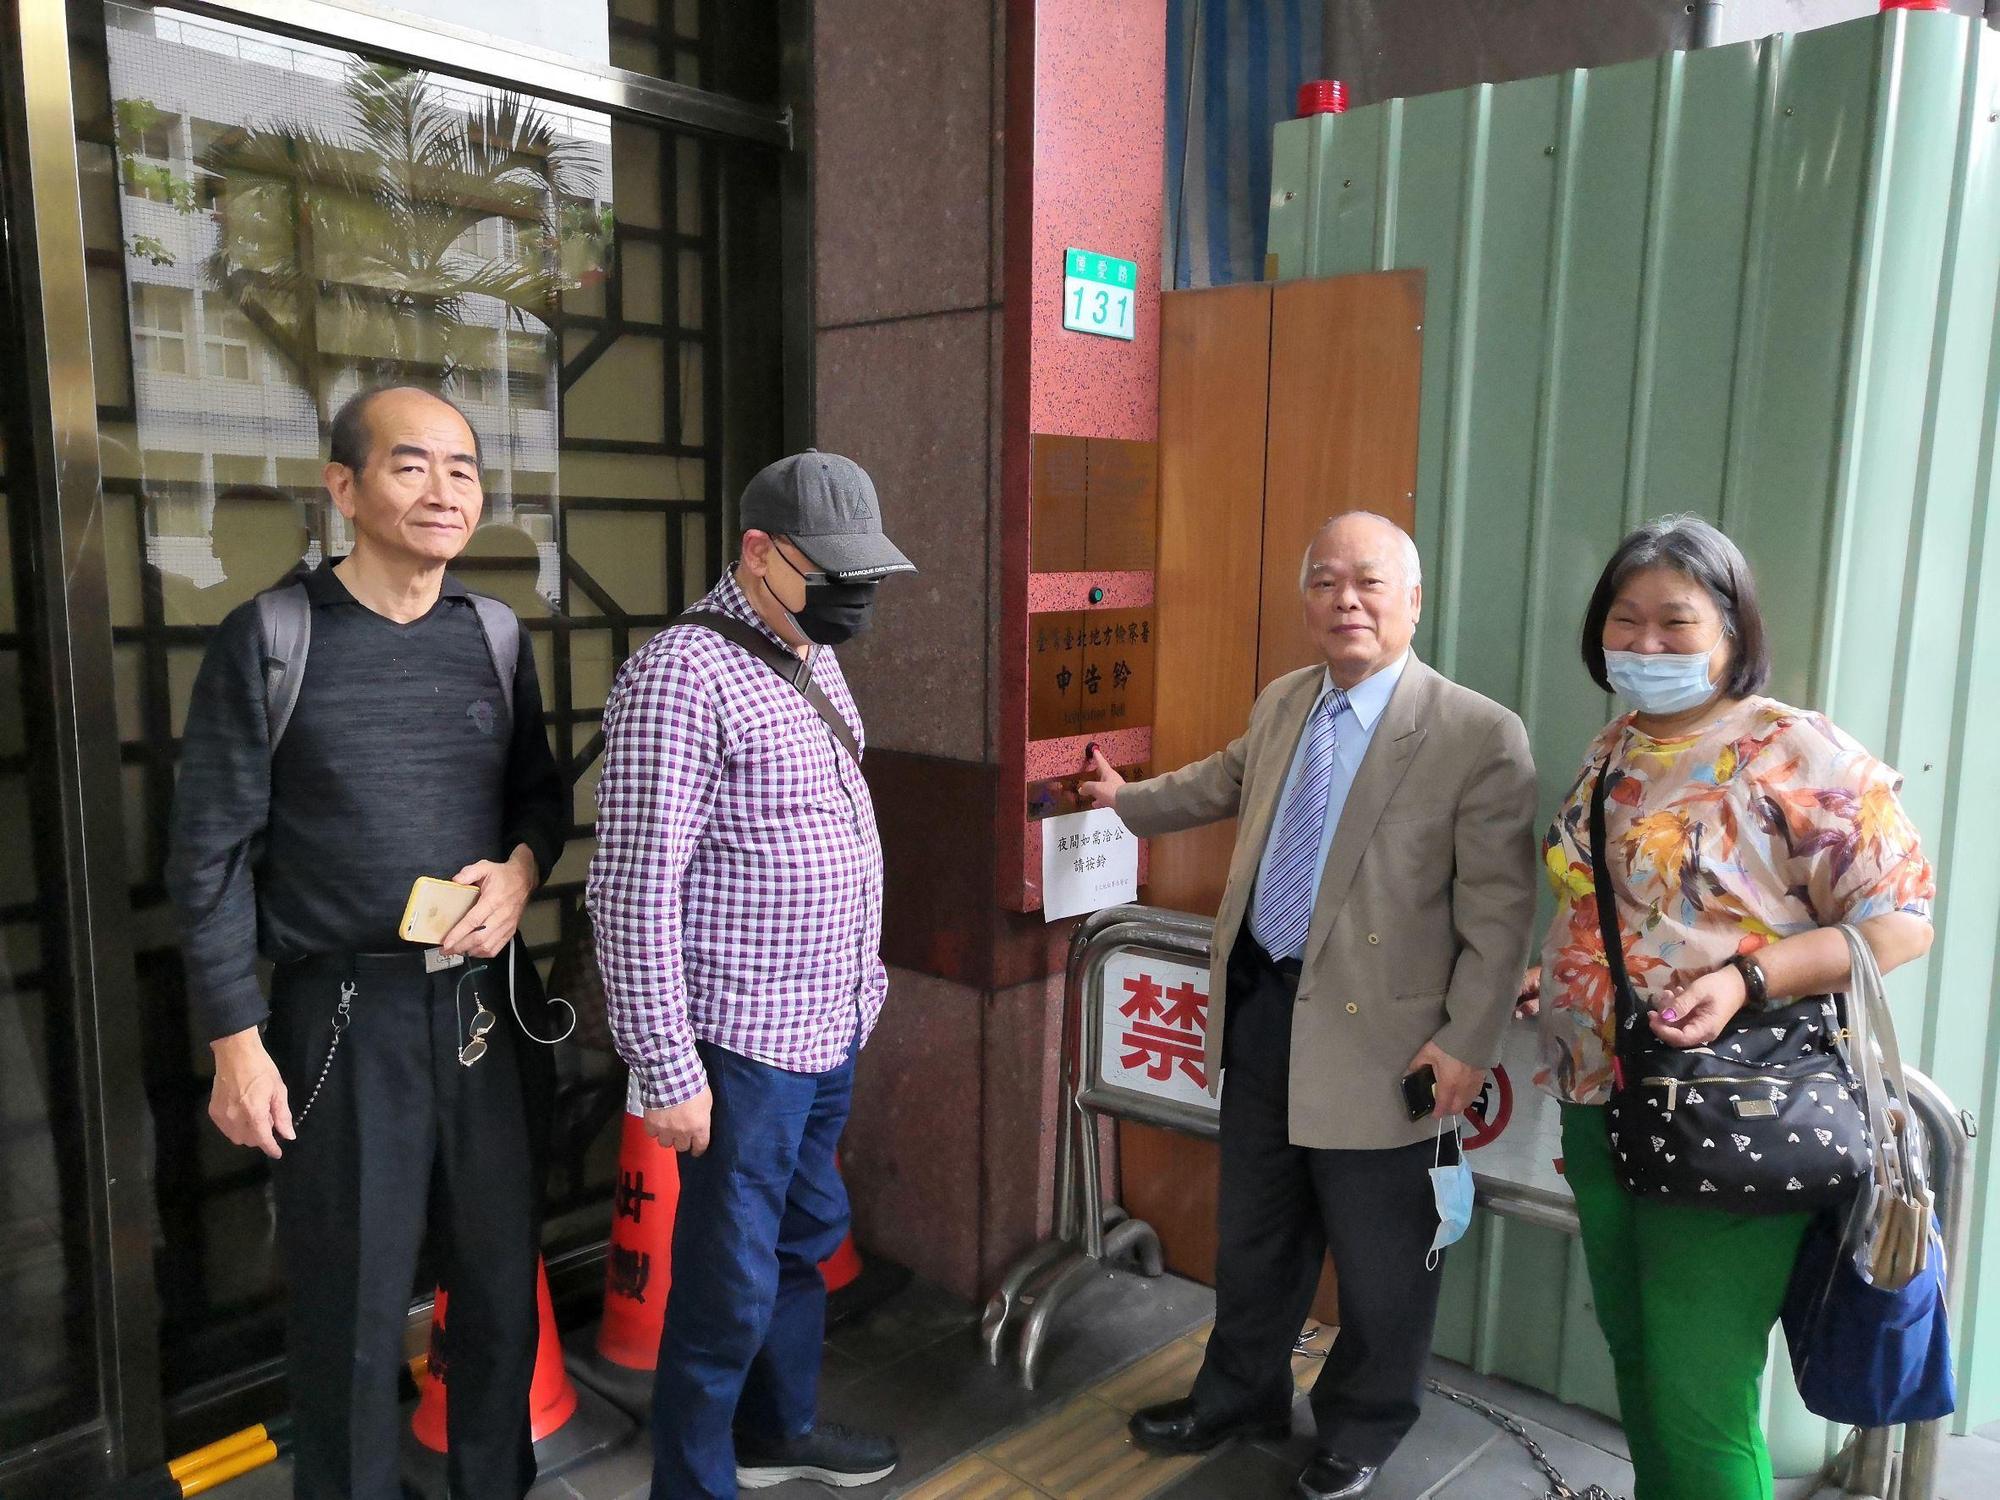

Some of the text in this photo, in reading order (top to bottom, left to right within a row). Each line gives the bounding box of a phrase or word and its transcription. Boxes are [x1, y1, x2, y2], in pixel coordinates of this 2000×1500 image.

[1073, 286, 1127, 327] 131
[1056, 660, 1132, 697] 申告鈴
[1057, 826, 1124, 852] 夜間如需洽公
[1073, 854, 1107, 873] 請按鈴
[1118, 973, 1209, 1090] 禁
